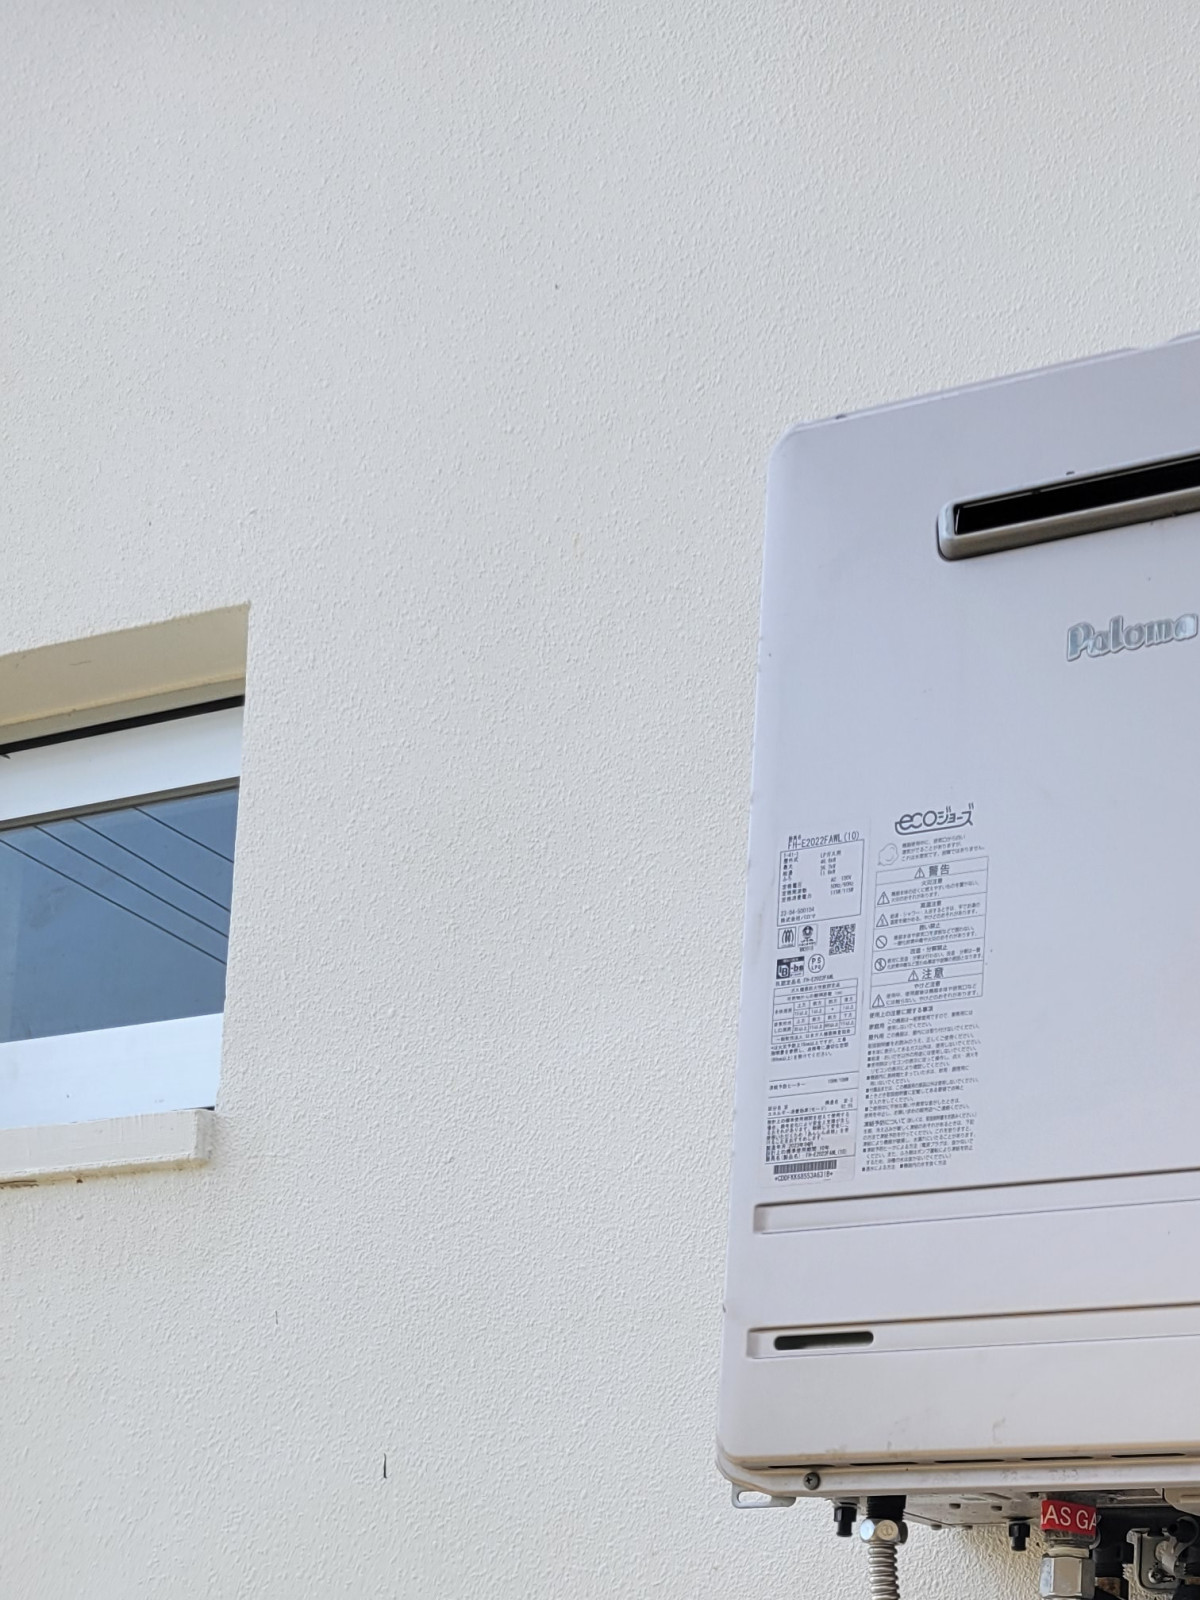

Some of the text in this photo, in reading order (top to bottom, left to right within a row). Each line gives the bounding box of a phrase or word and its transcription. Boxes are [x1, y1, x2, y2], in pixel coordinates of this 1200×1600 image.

[1066, 613, 1199, 662] Paloma
[929, 863, 950, 877] 警告
[922, 967, 944, 980] 注意
[1040, 1504, 1071, 1526] AS
